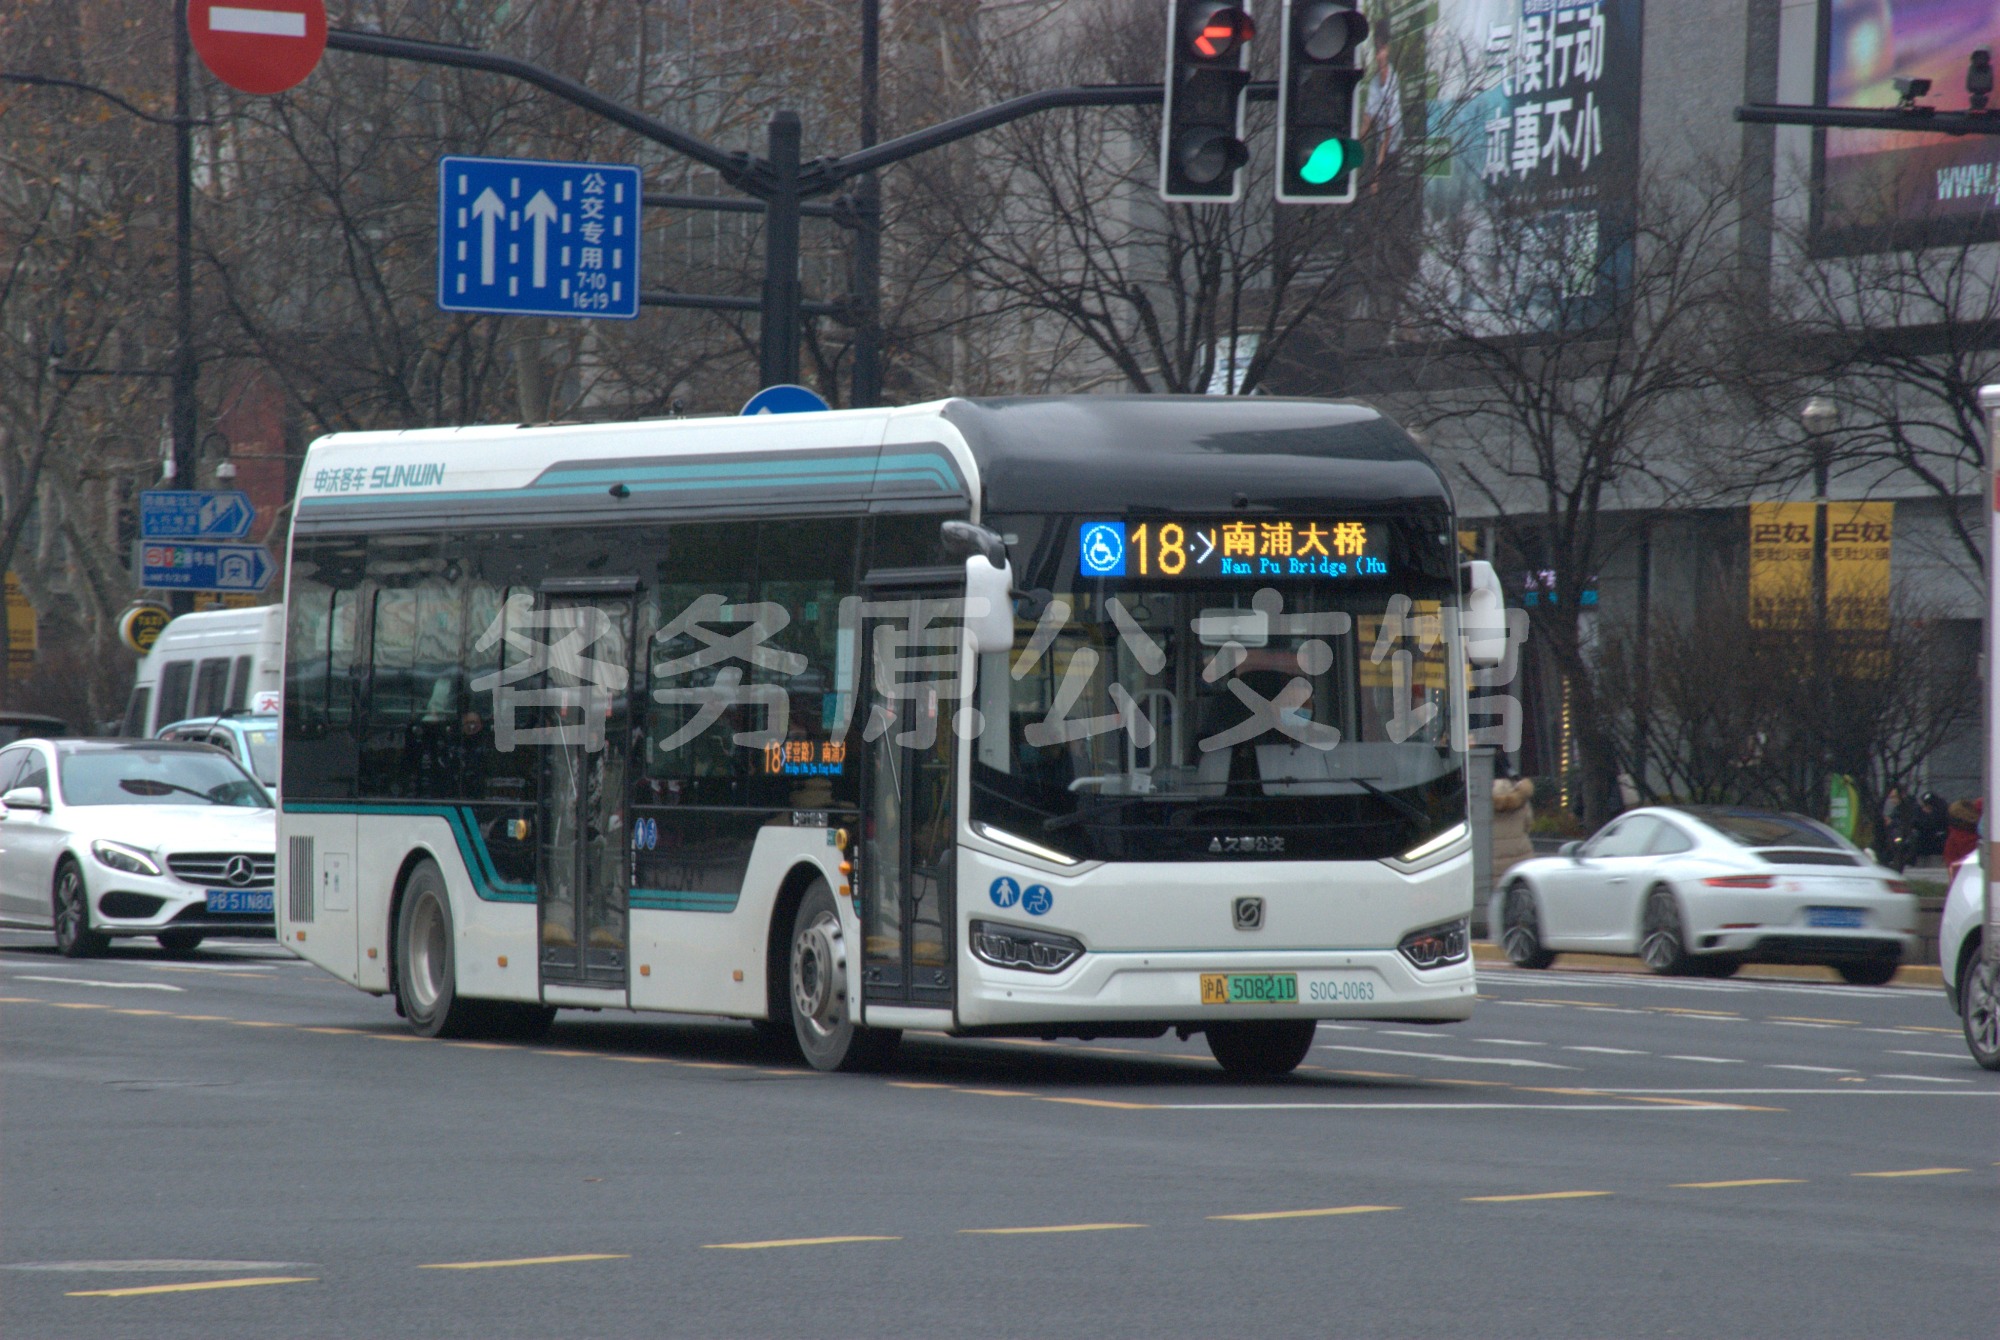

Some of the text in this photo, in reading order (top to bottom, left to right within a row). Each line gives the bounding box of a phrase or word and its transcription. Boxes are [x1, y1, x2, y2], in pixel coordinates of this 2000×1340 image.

[1486, 2, 1606, 97] 气候行动
[1482, 91, 1602, 185] 本事不小
[579, 172, 607, 270] 公交专用
[576, 271, 607, 291] 7-10
[572, 291, 609, 310] 16-19
[314, 466, 367, 493] 申沃客车
[369, 462, 446, 489] SUNWIN
[1222, 521, 1366, 556] 南浦大桥
[1754, 521, 1811, 544] 巴奴
[1831, 521, 1890, 543] 巴奴
[1131, 523, 1186, 575] 18
[1221, 556, 1387, 577] Nan Pu Bridge (Hu
[764, 741, 781, 774] 18
